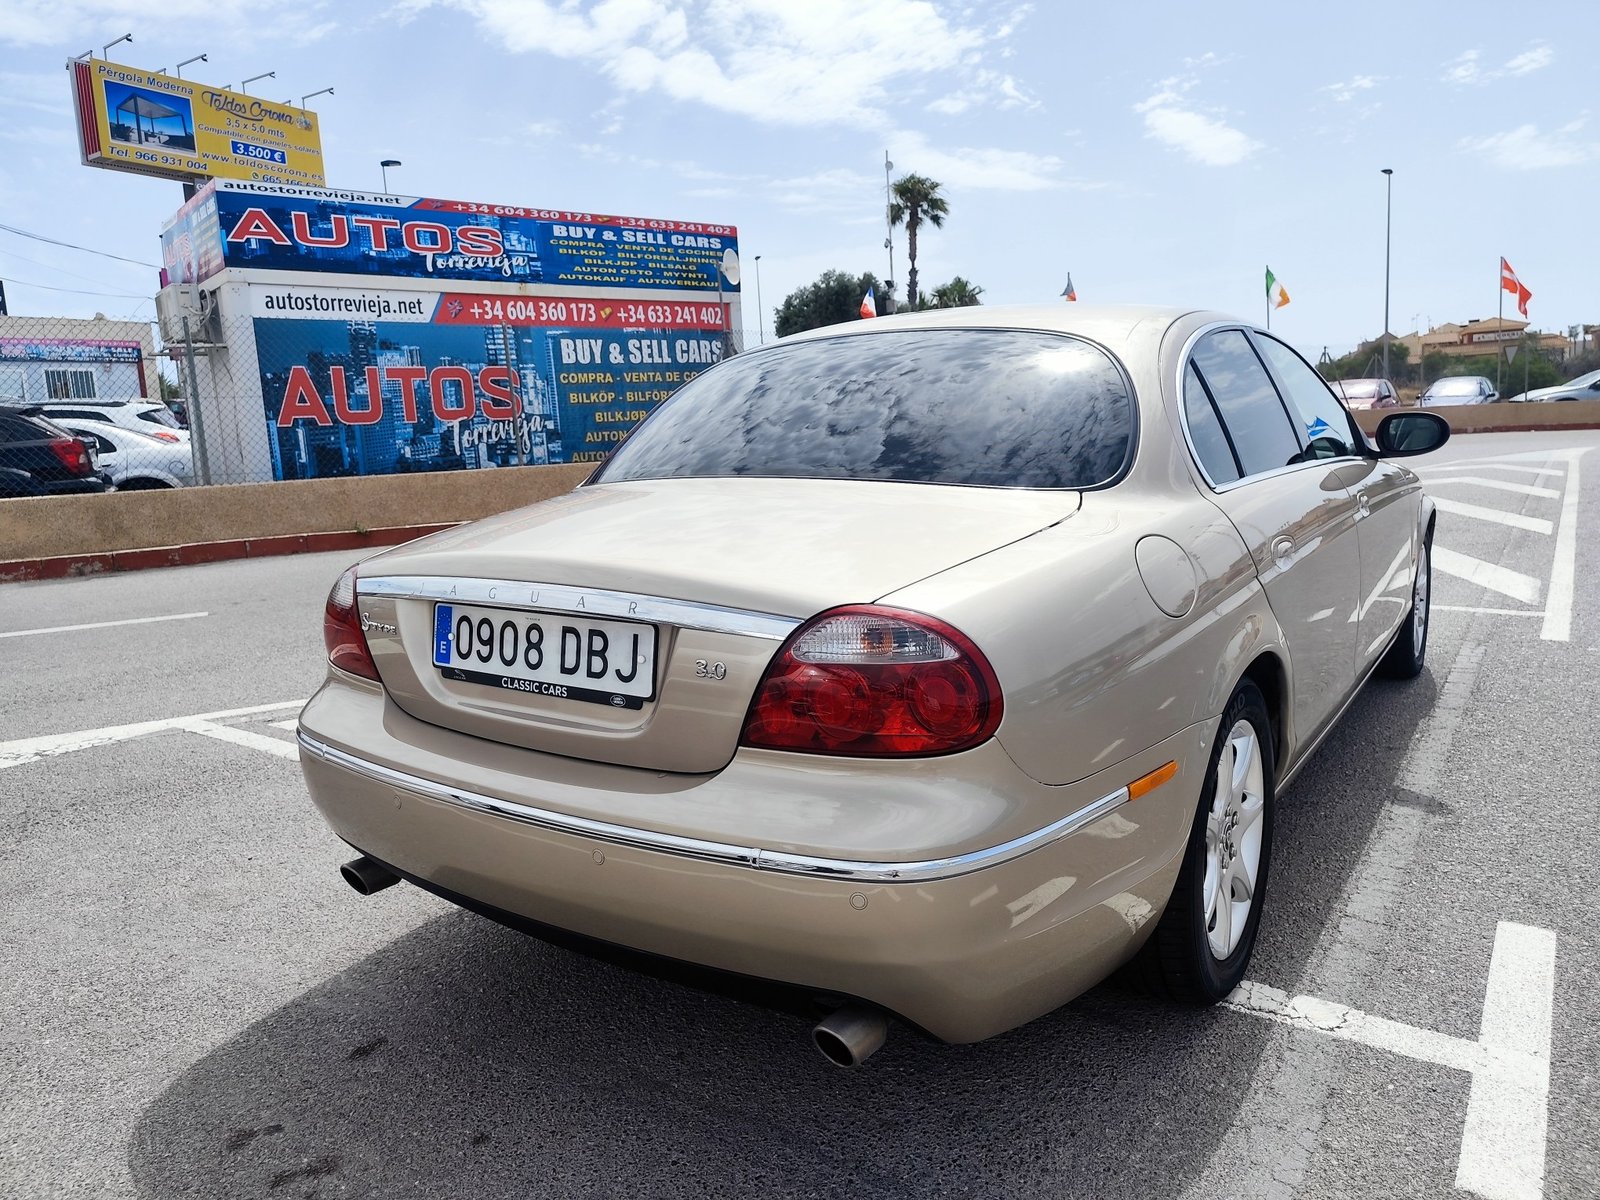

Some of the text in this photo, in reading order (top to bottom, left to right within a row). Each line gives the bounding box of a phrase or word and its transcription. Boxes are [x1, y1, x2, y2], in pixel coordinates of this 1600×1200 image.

[98, 65, 194, 95] Pérgola Moderna
[201, 90, 293, 125] Toldos Corona
[198, 123, 321, 155] Compatible con paneles solares
[108, 146, 208, 171] Tel. 966 931 004
[236, 143, 283, 162] 3.500 €
[201, 152, 324, 181] www.toldoscorona.es
[262, 174, 281, 184] 665
[223, 180, 402, 205] autostorrevieja.net
[453, 203, 592, 223] +34 604 360 173
[227, 207, 504, 257] AUTOS
[552, 224, 723, 250] BUY & SELL CARS
[615, 217, 732, 236] +34 633 241 402
[550, 239, 605, 248] COMPRA
[616, 244, 656, 252] VENTA
[418, 252, 528, 277] Torrevieja
[573, 266, 617, 274] AUTON
[620, 269, 654, 277] OSTO
[663, 271, 708, 279] MYYNTI
[584, 258, 637, 267] BILKJØP
[648, 262, 697, 271] BILSALG
[558, 274, 627, 283] AUTOKAUF
[265, 292, 425, 318] autostorrevieja.net
[469, 301, 596, 322] +34 604 360 173
[617, 305, 723, 324] +34 633 241 402
[560, 339, 723, 363] BUY & SELL CARS
[560, 373, 613, 384] COMPRA
[624, 372, 662, 383] VENTA
[665, 372, 680, 382] DE
[277, 365, 523, 427] AUTOS
[569, 390, 615, 404] BILKÖP
[626, 389, 672, 402] BILFÖR
[595, 411, 647, 422] BILKJØP
[446, 412, 546, 457] Torrevieja
[585, 431, 627, 443] AUTON
[572, 452, 610, 463] AUTO
[419, 582, 639, 615] JAGUAR
[440, 641, 447, 654] E
[455, 614, 639, 683] 0908 DBJ
[696, 659, 726, 680] 3.0
[501, 677, 568, 698] CLASSIC CARS
